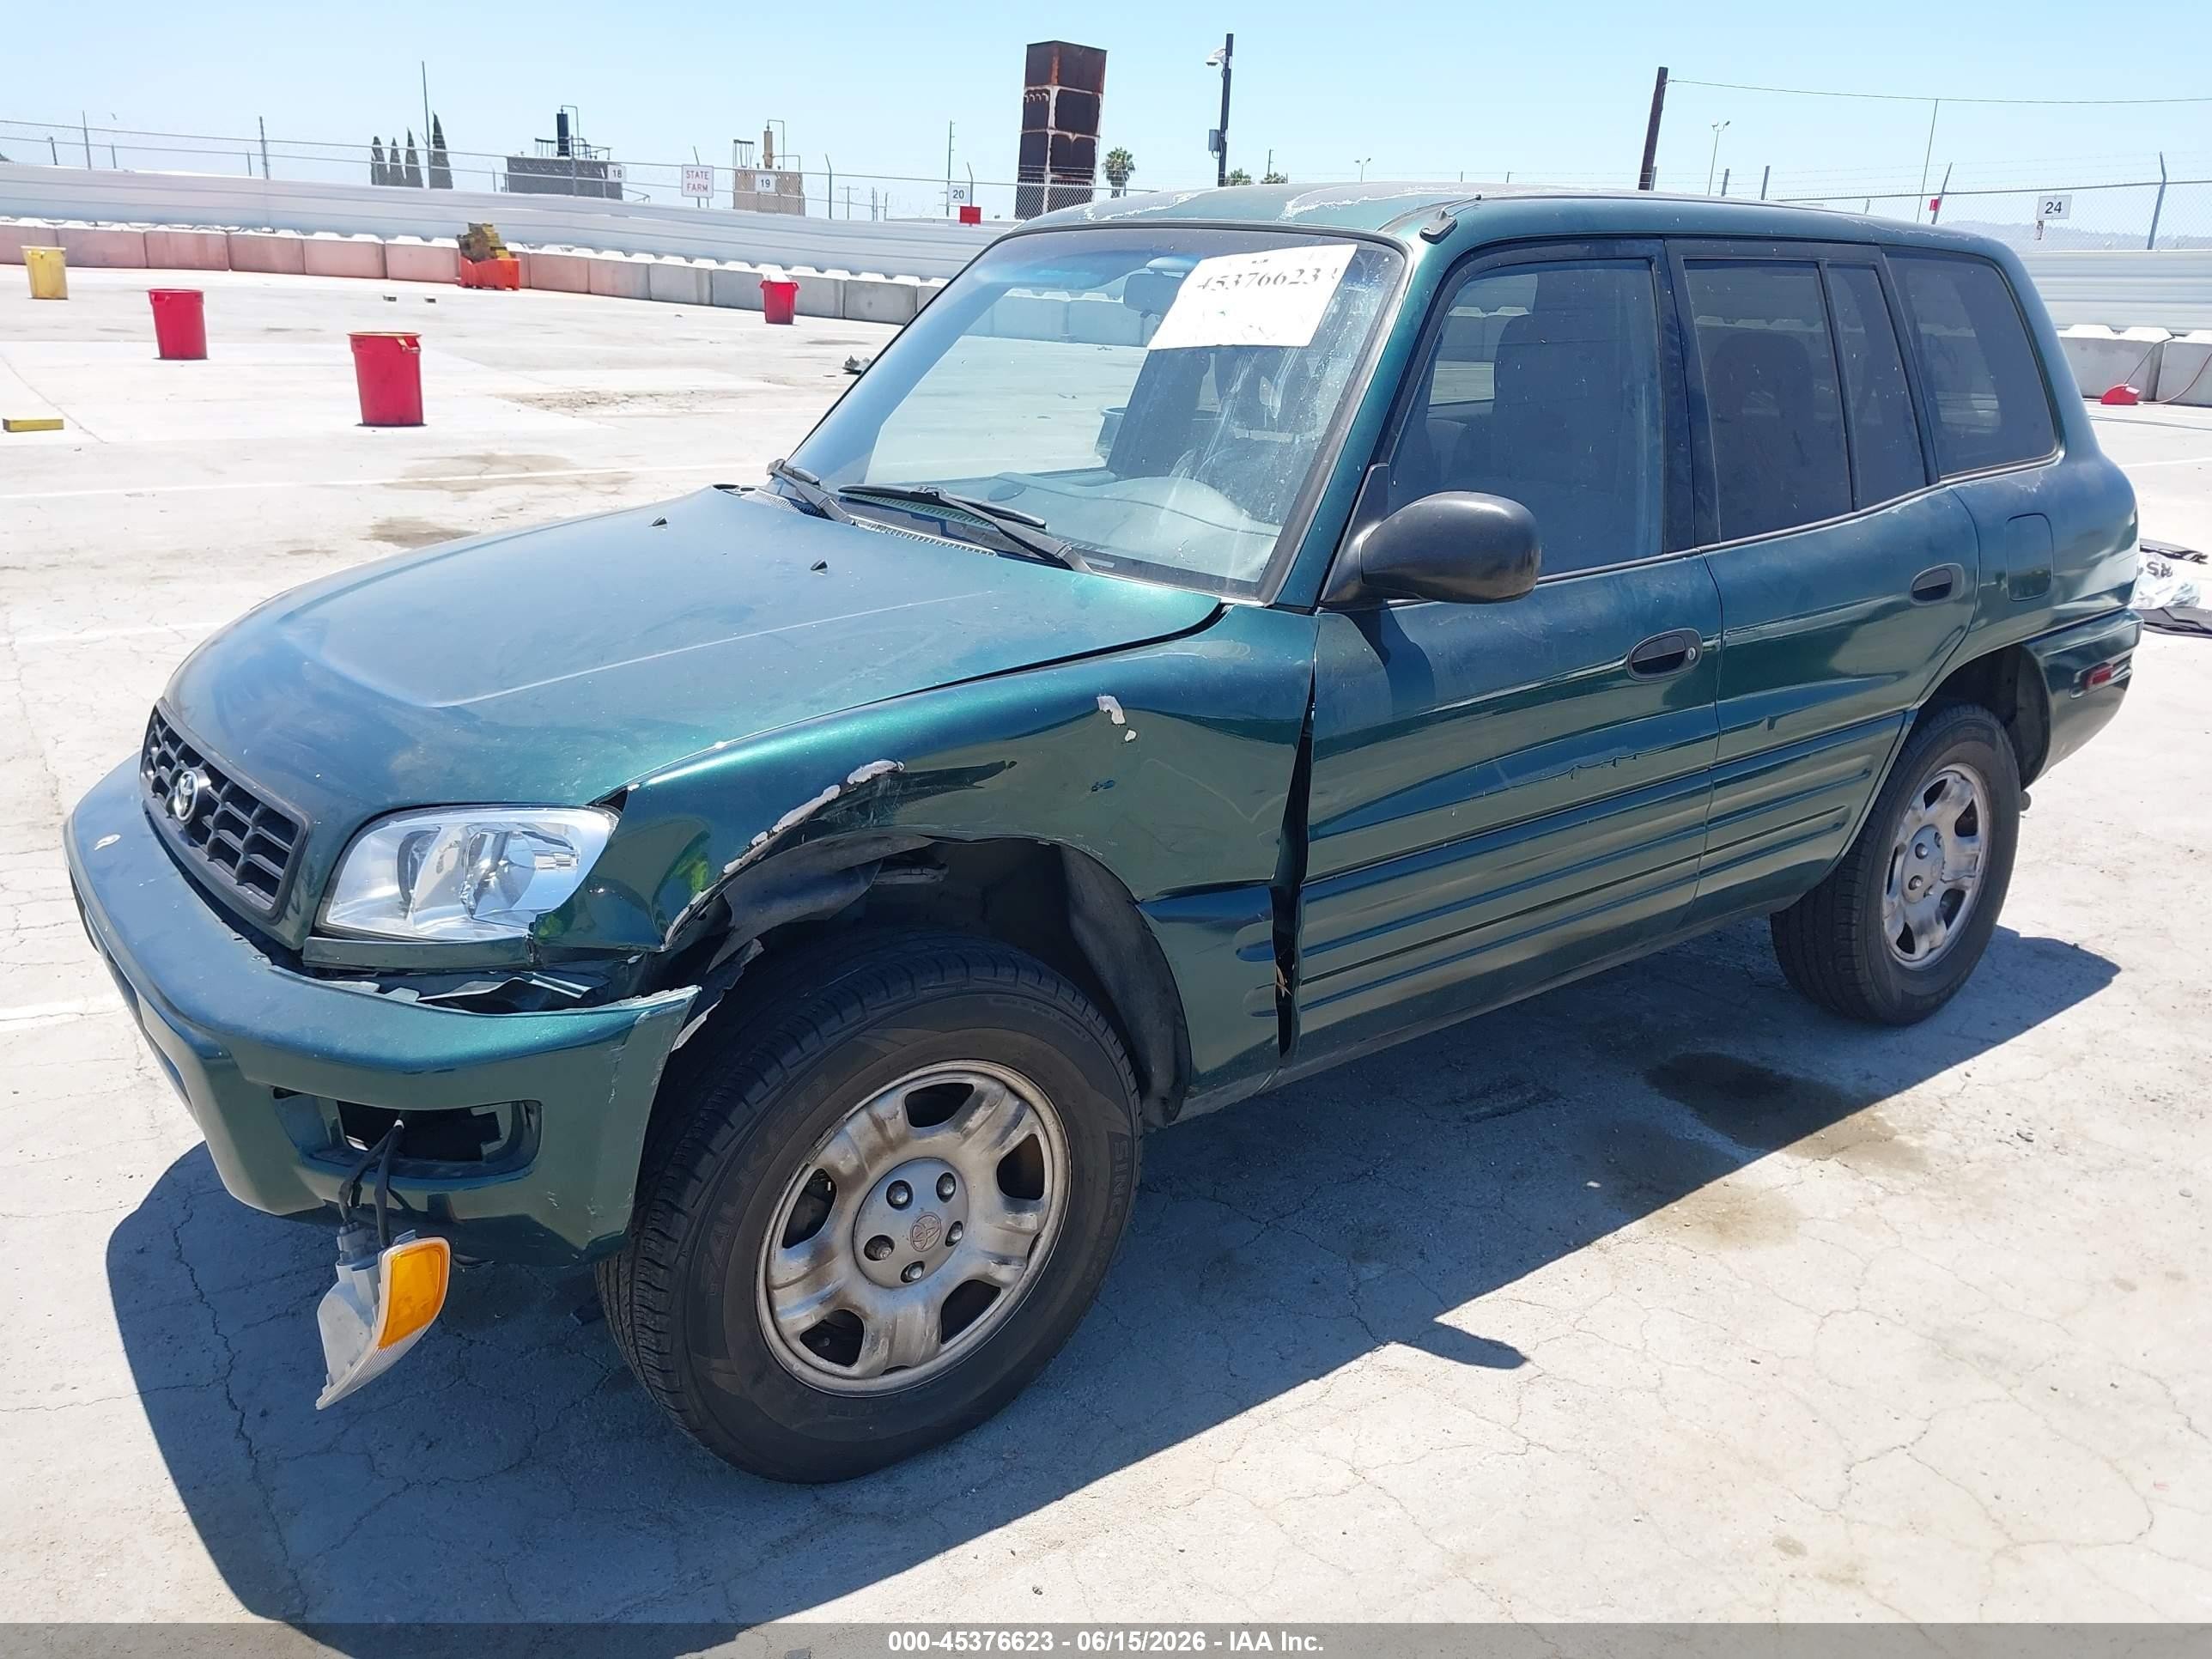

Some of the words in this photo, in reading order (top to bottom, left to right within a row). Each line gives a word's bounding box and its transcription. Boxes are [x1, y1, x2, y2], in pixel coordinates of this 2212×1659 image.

[611, 169, 623, 179] 18
[686, 170, 709, 179] STATE
[686, 183, 708, 192] FARM
[761, 179, 771, 188] 19
[952, 189, 965, 199] 20
[2045, 201, 2063, 214] 24
